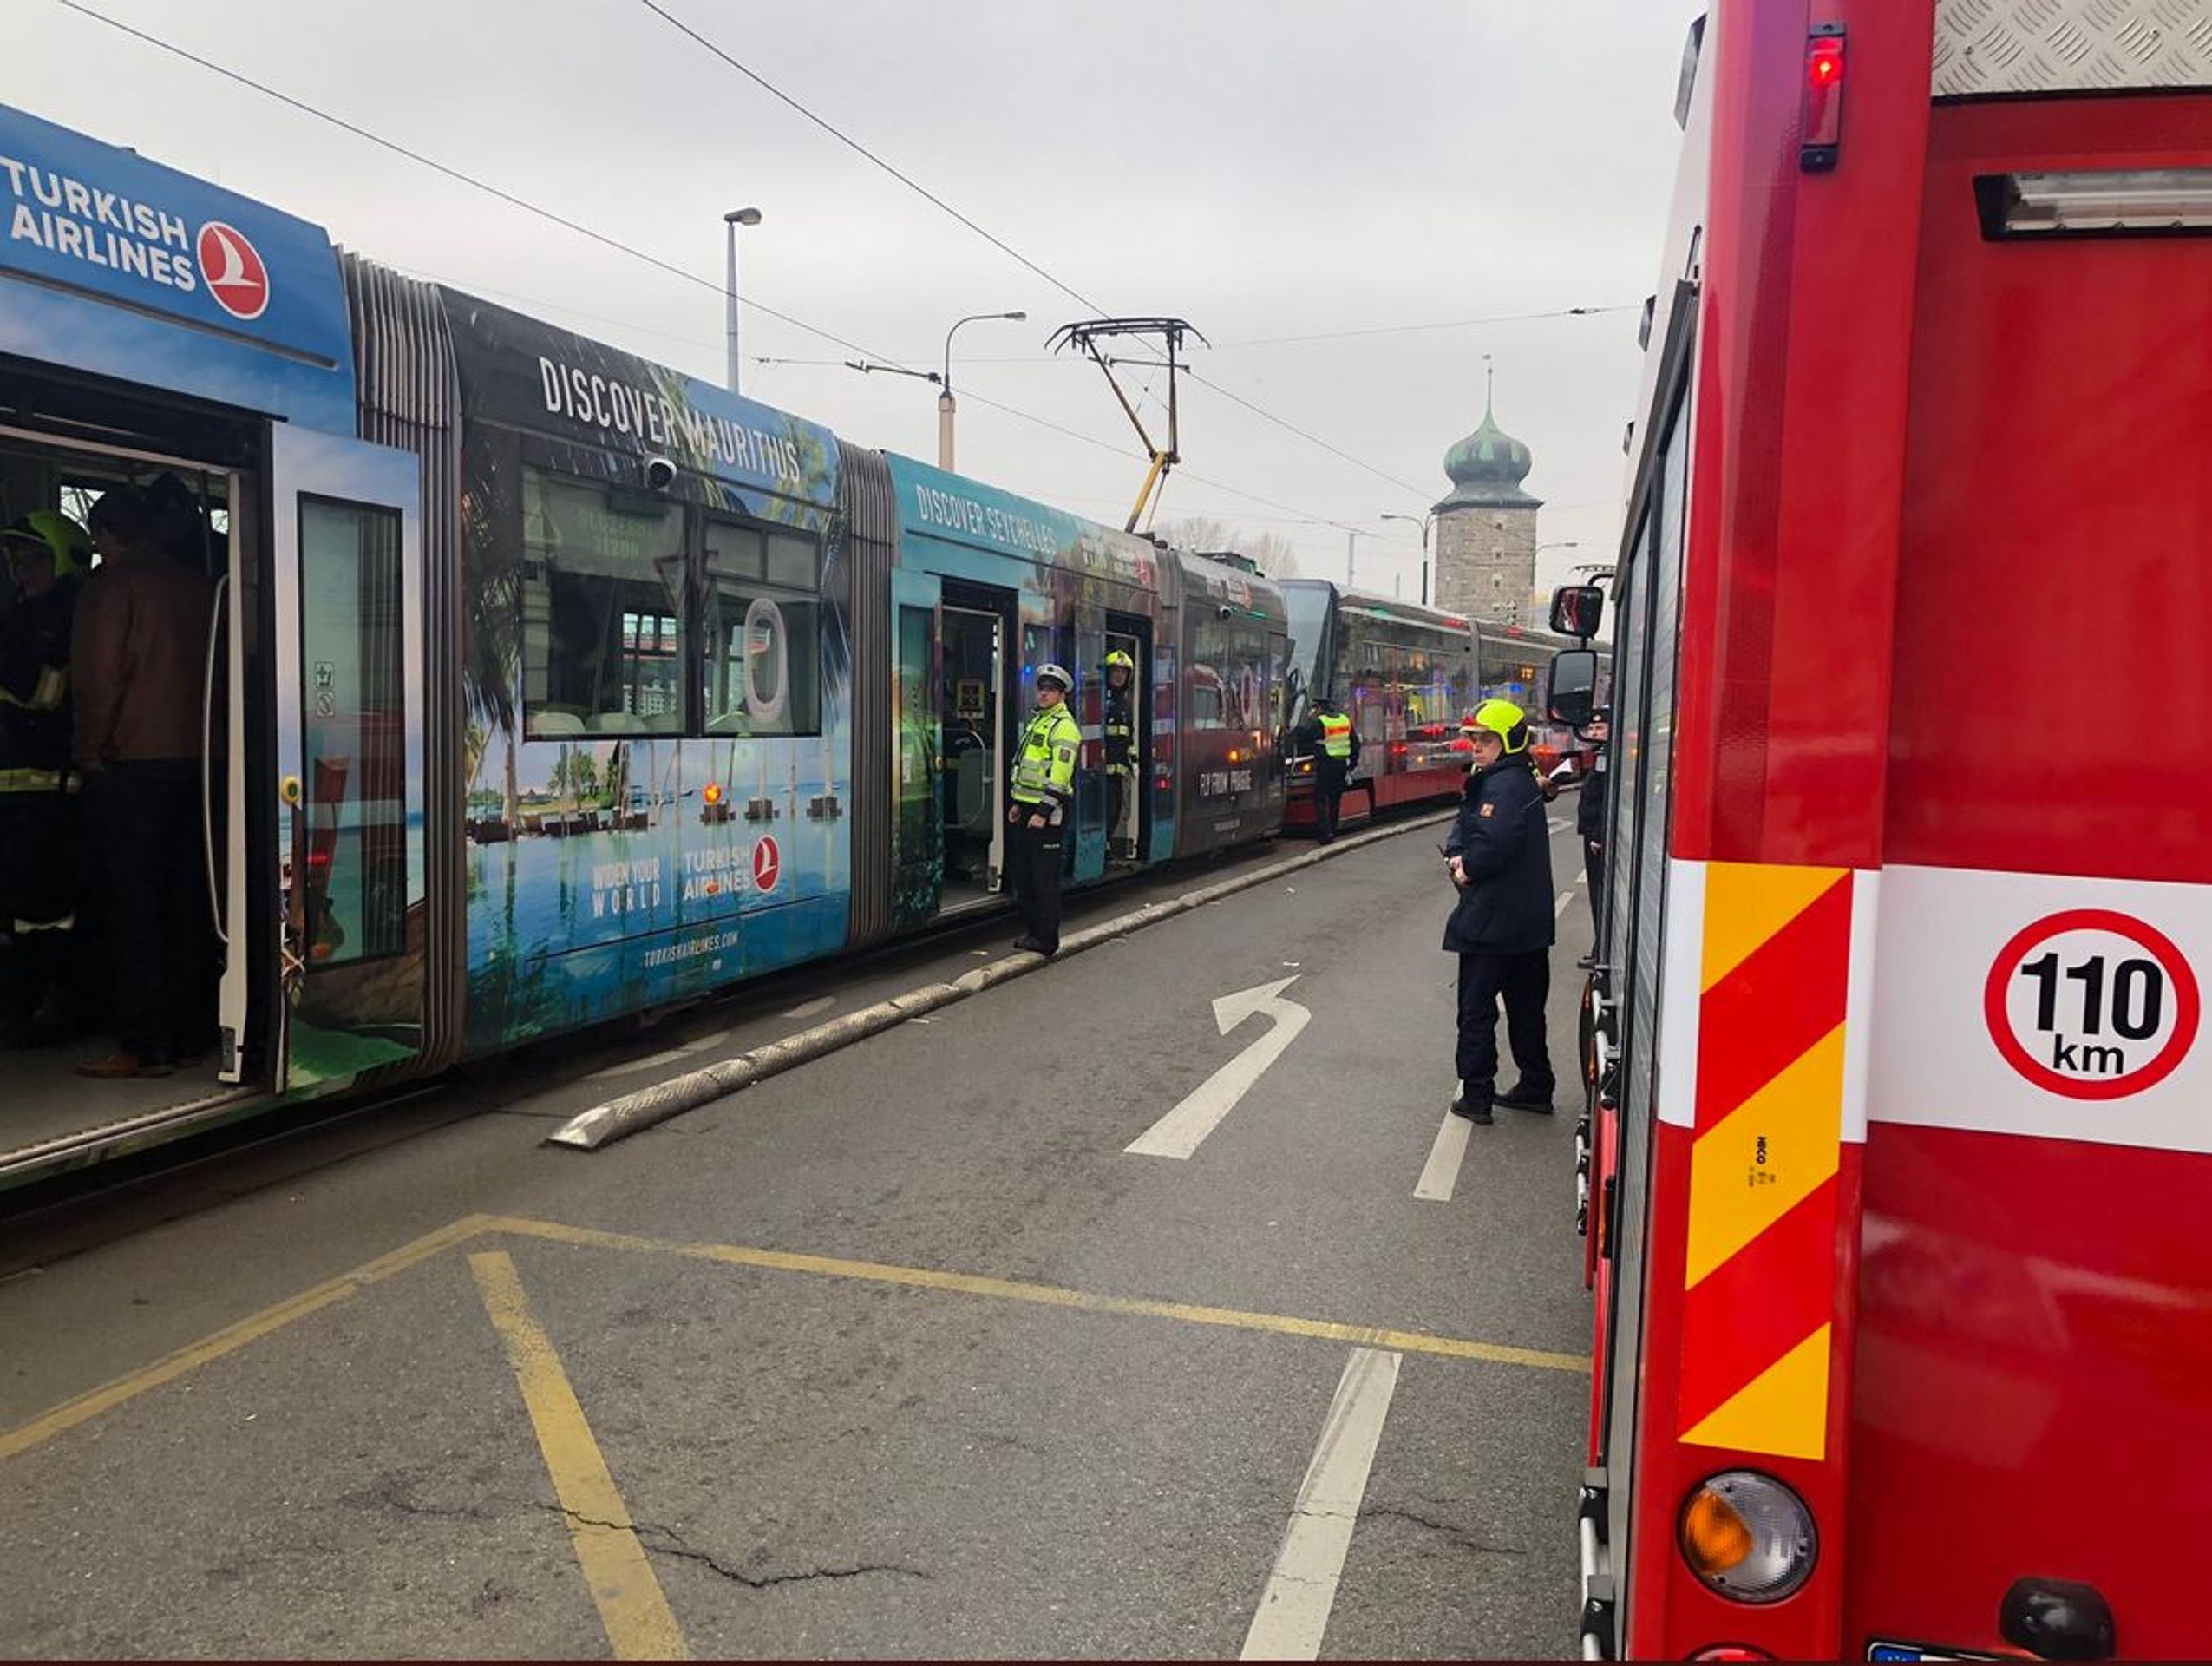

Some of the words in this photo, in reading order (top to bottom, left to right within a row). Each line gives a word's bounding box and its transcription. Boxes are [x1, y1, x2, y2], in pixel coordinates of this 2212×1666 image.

[0, 155, 188, 251] TURKISH
[10, 203, 196, 292] AIRLINES
[538, 356, 679, 448] DISCOVER
[682, 407, 801, 483] MAURITIUS
[916, 483, 986, 536] DISCOVER
[632, 856, 660, 884] YOUR
[682, 844, 751, 874] TURKISH
[592, 882, 660, 919] WORLD
[2020, 951, 2163, 1040] 110
[2052, 1033, 2124, 1075] km
